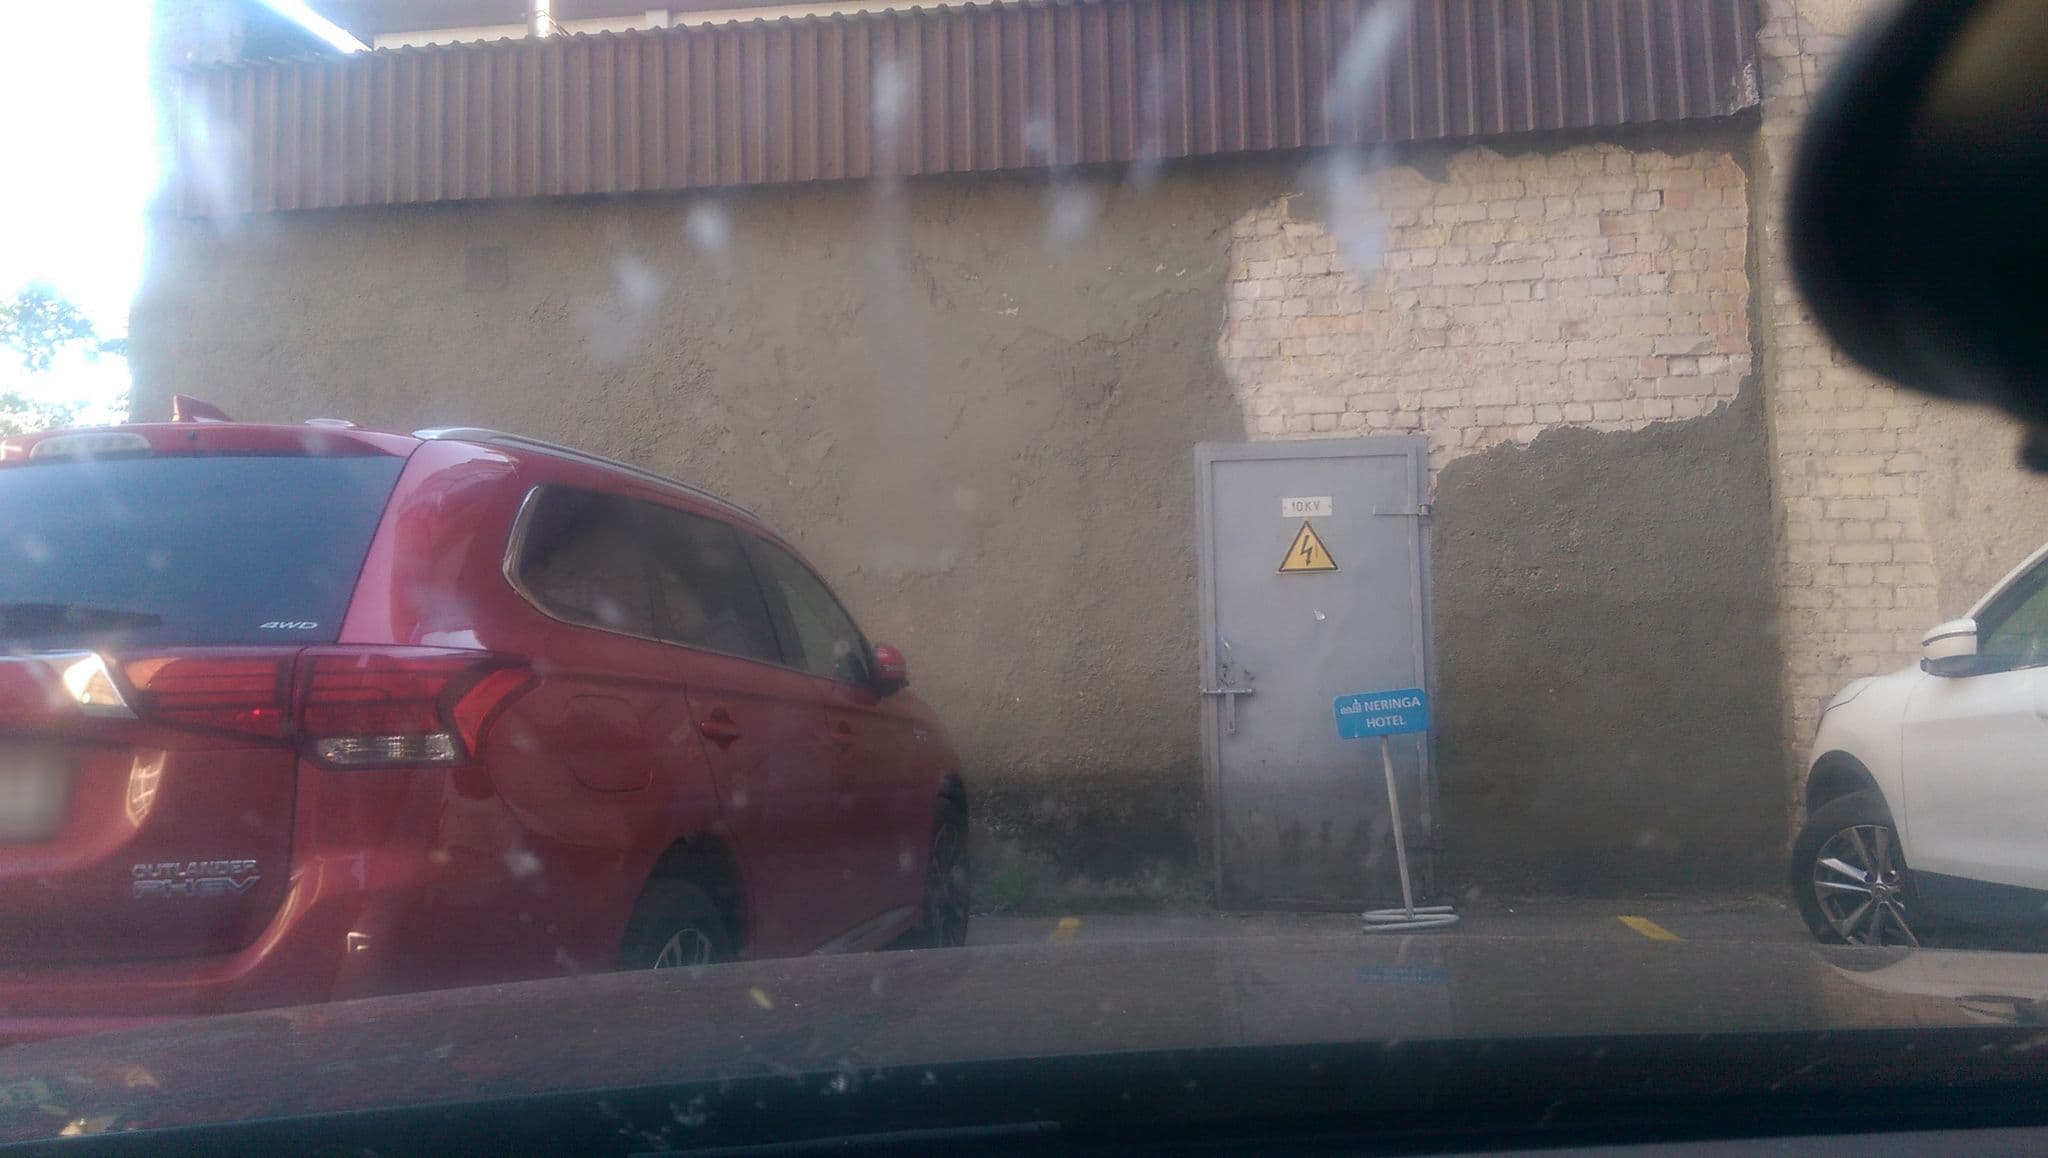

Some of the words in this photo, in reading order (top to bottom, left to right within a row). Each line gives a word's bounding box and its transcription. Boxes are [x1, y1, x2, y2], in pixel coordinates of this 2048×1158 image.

[260, 621, 318, 629] 4WD
[1364, 696, 1421, 712] NERINGA
[1366, 715, 1407, 728] HOTEL
[132, 859, 257, 877] OUTLANDER
